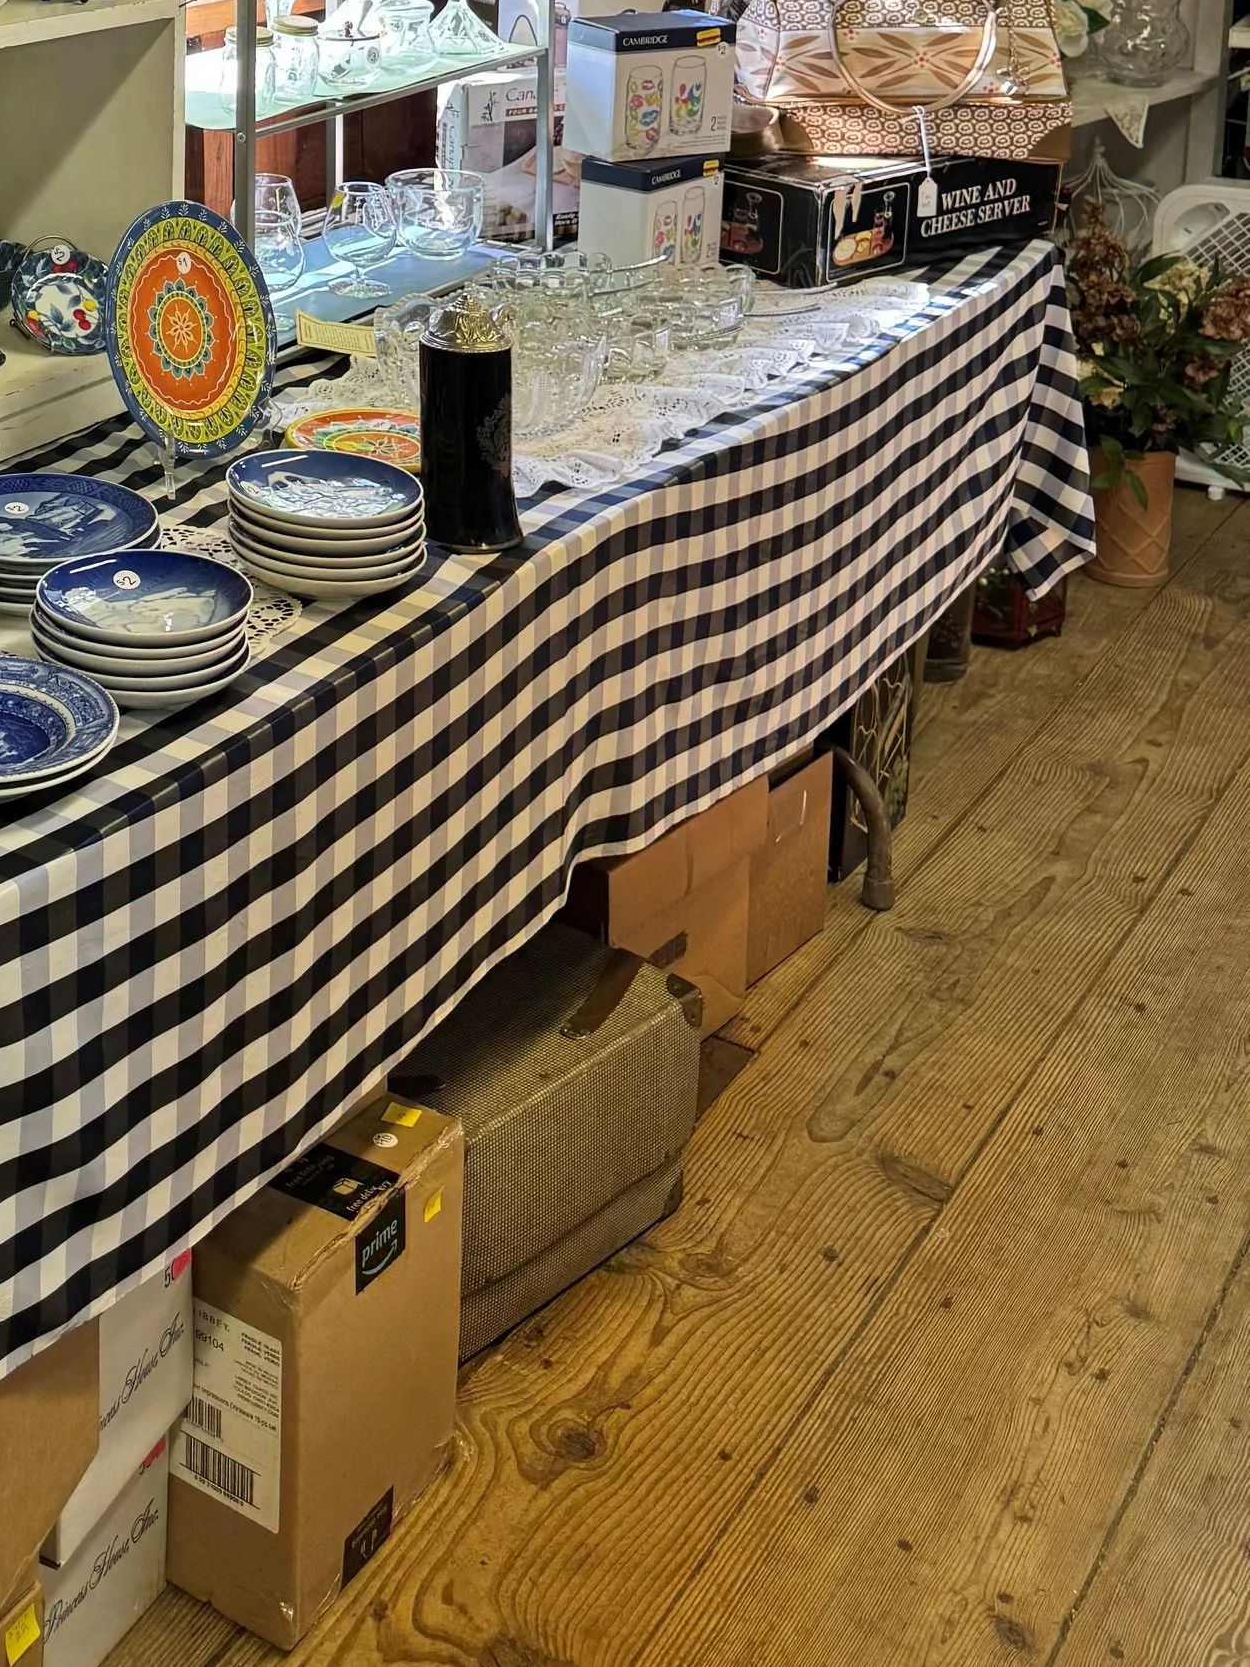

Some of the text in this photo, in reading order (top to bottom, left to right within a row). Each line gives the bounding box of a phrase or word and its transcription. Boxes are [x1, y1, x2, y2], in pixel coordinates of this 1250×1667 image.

[622, 34, 669, 46] CAMBRIDGE
[717, 44, 726, 55] $2
[711, 116, 717, 132] 2
[651, 168, 682, 185] CAMBRIDGE
[941, 185, 982, 211] WINE
[983, 177, 1017, 202] AND
[920, 194, 1031, 238] CHEESE SERVER
[53, 247, 65, 262] $2
[178, 256, 188, 268] $1
[6, 505, 23, 513] $2
[116, 575, 137, 586] $2
[345, 1200, 362, 1212] free
[361, 1218, 399, 1268] prime
[121, 1347, 159, 1404] House,
[159, 1312, 185, 1356] Inc.
[202, 1386, 230, 1407] Impressions
[42, 1498, 159, 1645] Princess House, Inc.
